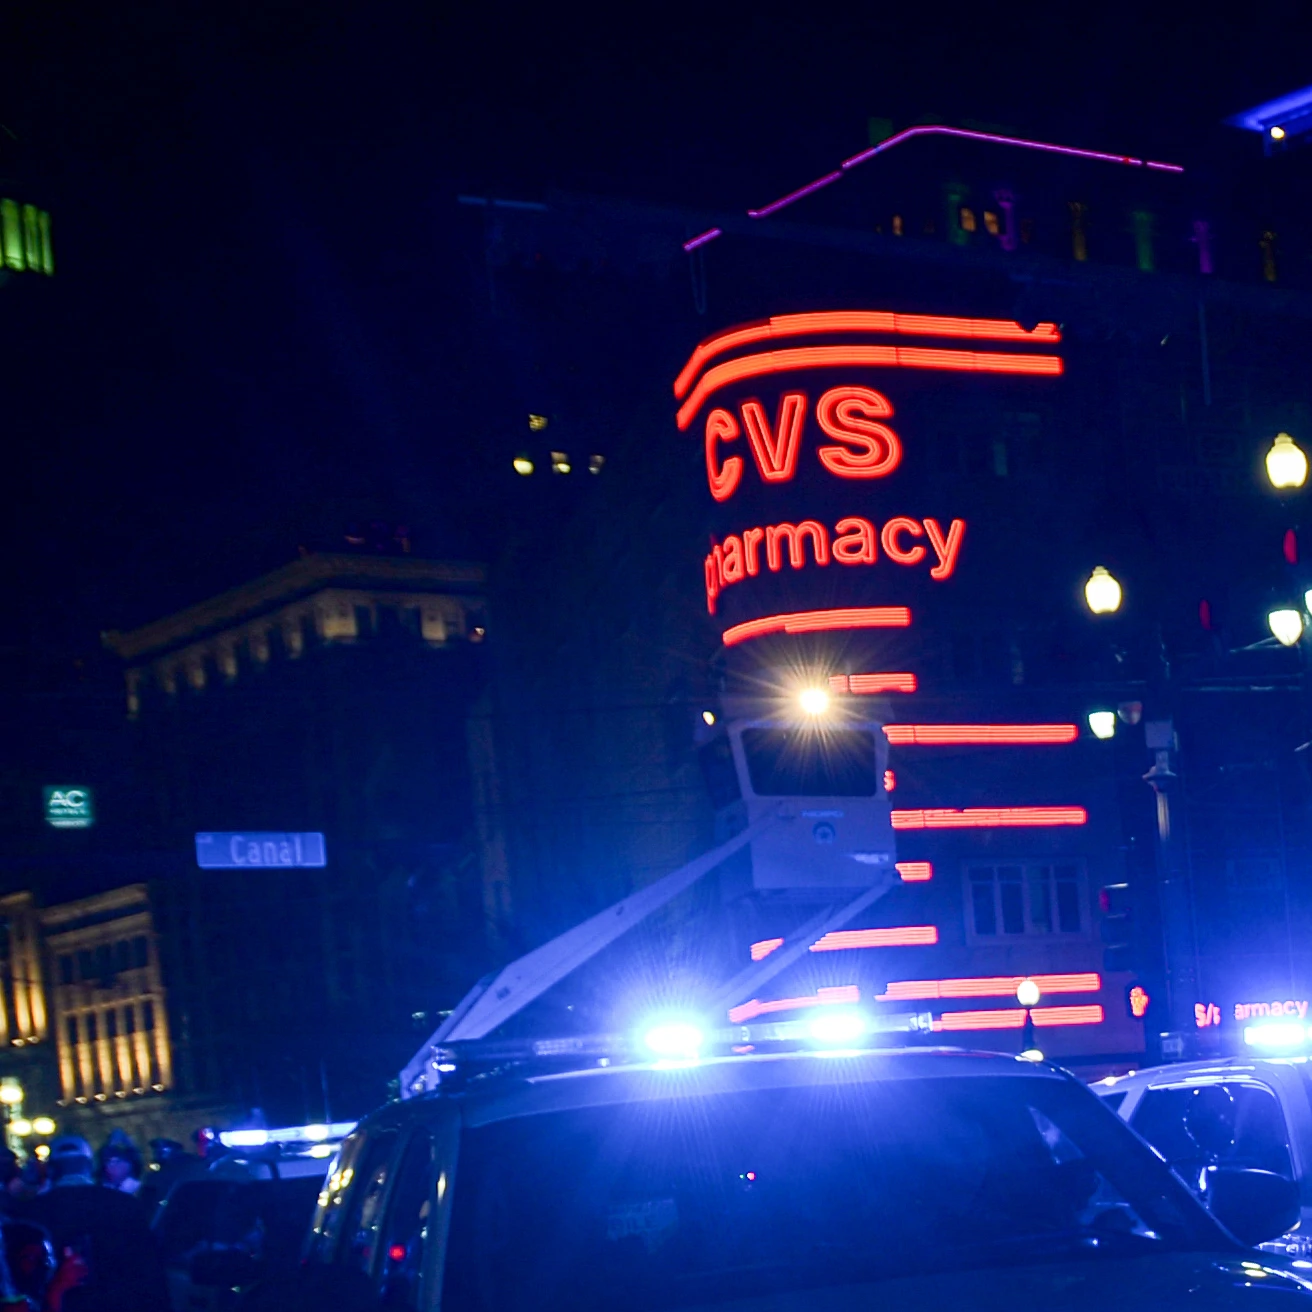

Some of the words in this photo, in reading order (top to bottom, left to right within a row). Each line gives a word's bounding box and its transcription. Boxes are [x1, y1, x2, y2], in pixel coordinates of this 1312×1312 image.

[705, 386, 902, 501] CVS
[48, 789, 86, 807] AC
[229, 835, 303, 864] Canal
